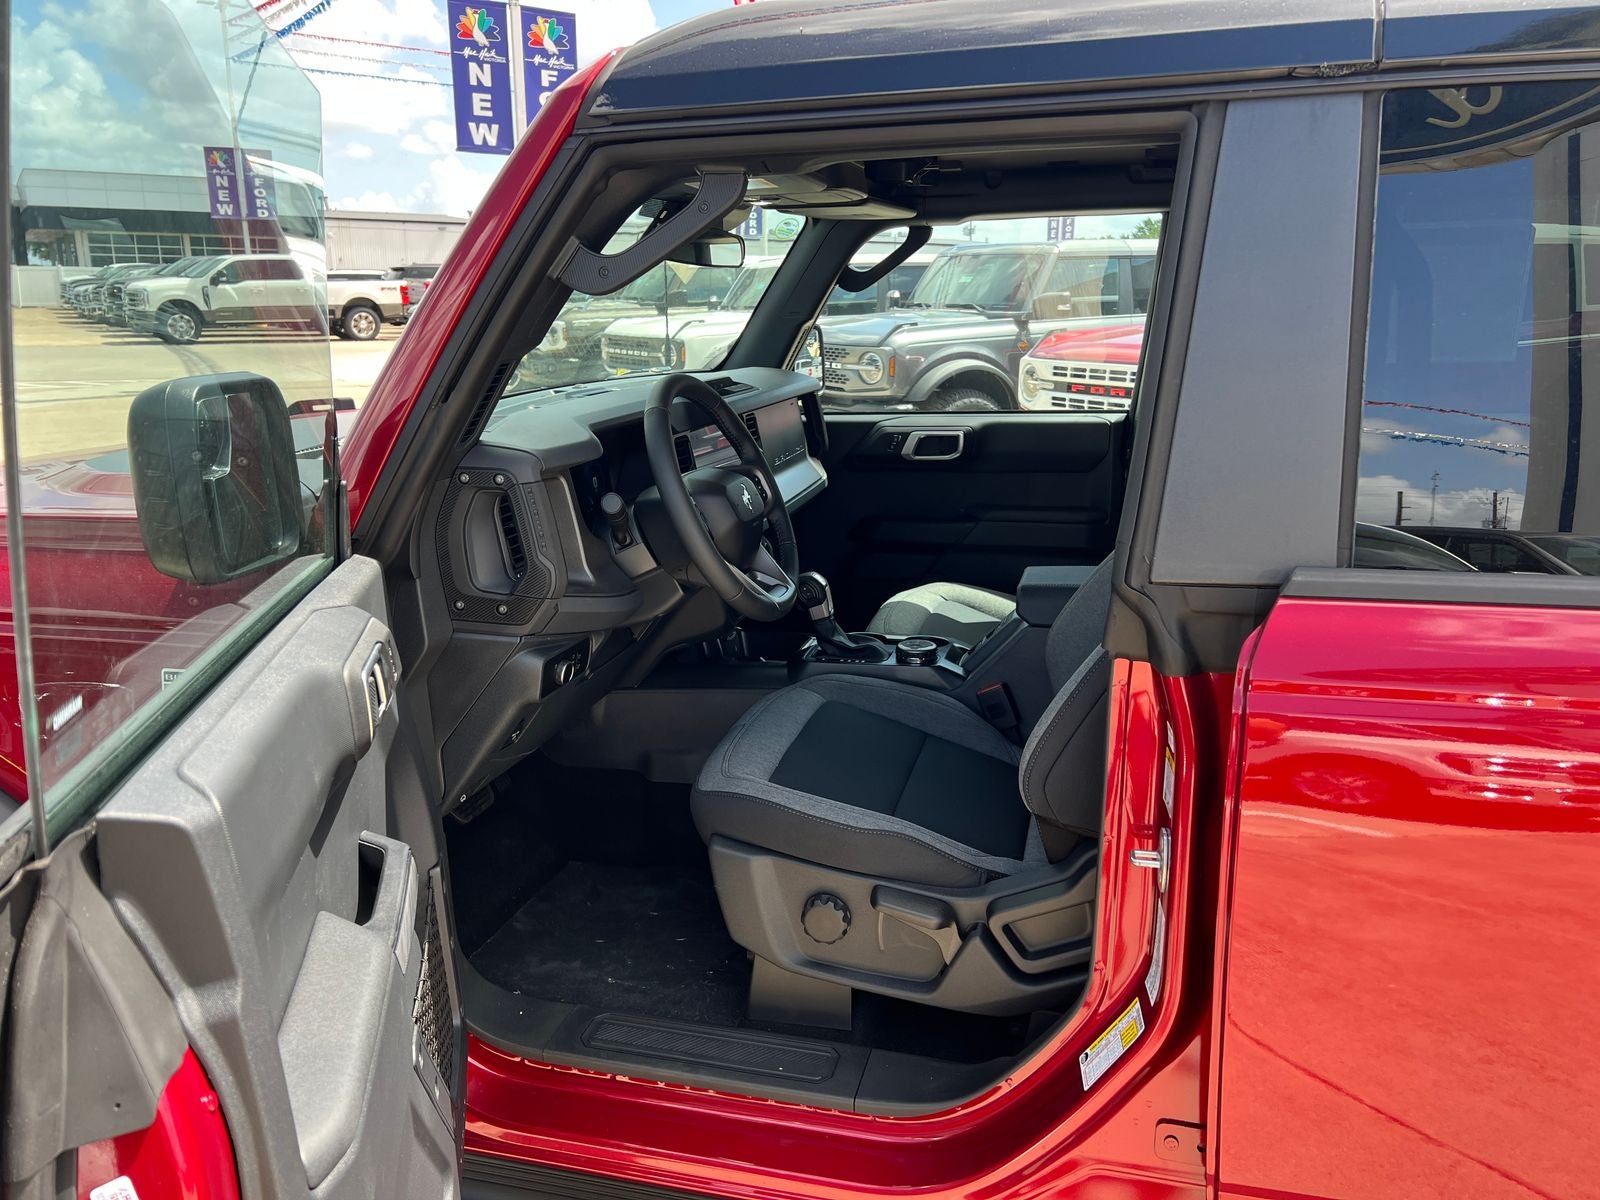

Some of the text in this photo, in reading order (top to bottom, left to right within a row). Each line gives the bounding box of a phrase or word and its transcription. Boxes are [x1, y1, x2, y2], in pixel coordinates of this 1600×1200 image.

[468, 62, 499, 146] NEW
[215, 175, 233, 215] NEW
[254, 178, 269, 217] FORD
[1071, 383, 1134, 397] FOR
